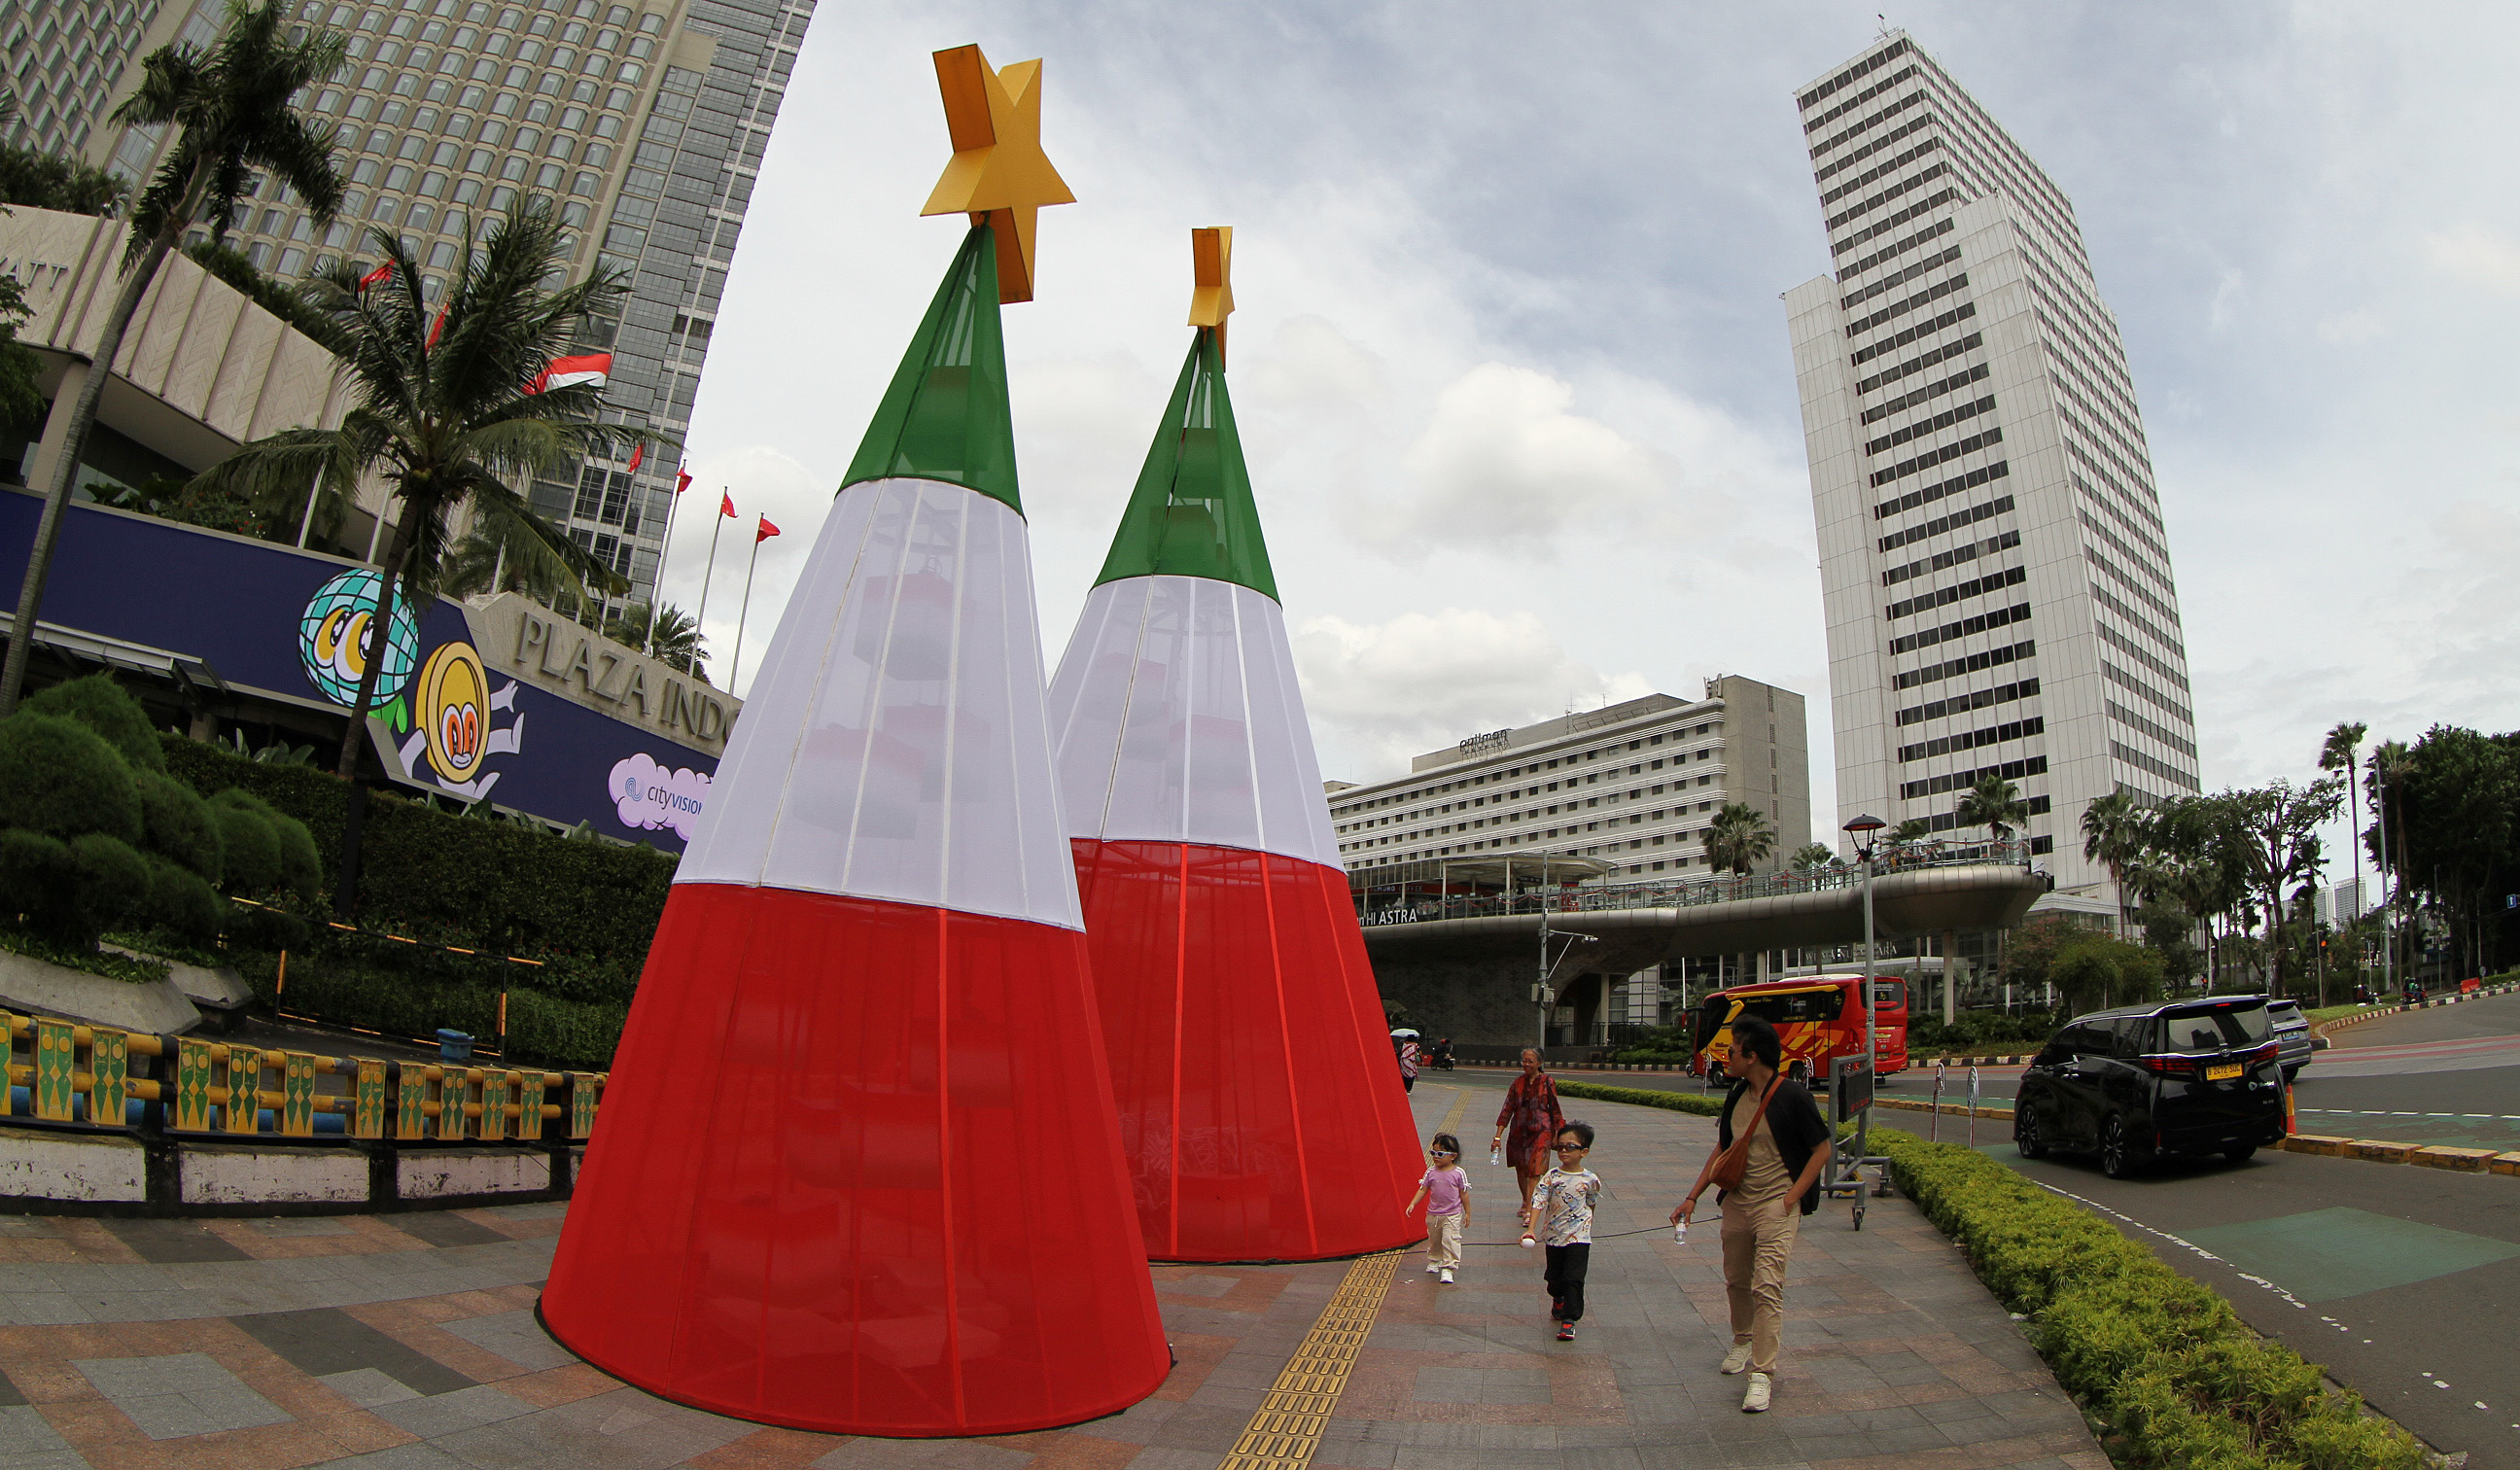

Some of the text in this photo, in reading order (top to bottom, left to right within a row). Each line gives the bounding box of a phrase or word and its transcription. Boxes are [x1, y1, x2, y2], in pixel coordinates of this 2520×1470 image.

[0, 256, 69, 292] ATT
[515, 611, 651, 716] PLAZA
[1366, 911, 1376, 926] HI
[1379, 908, 1418, 926] ASTRA
